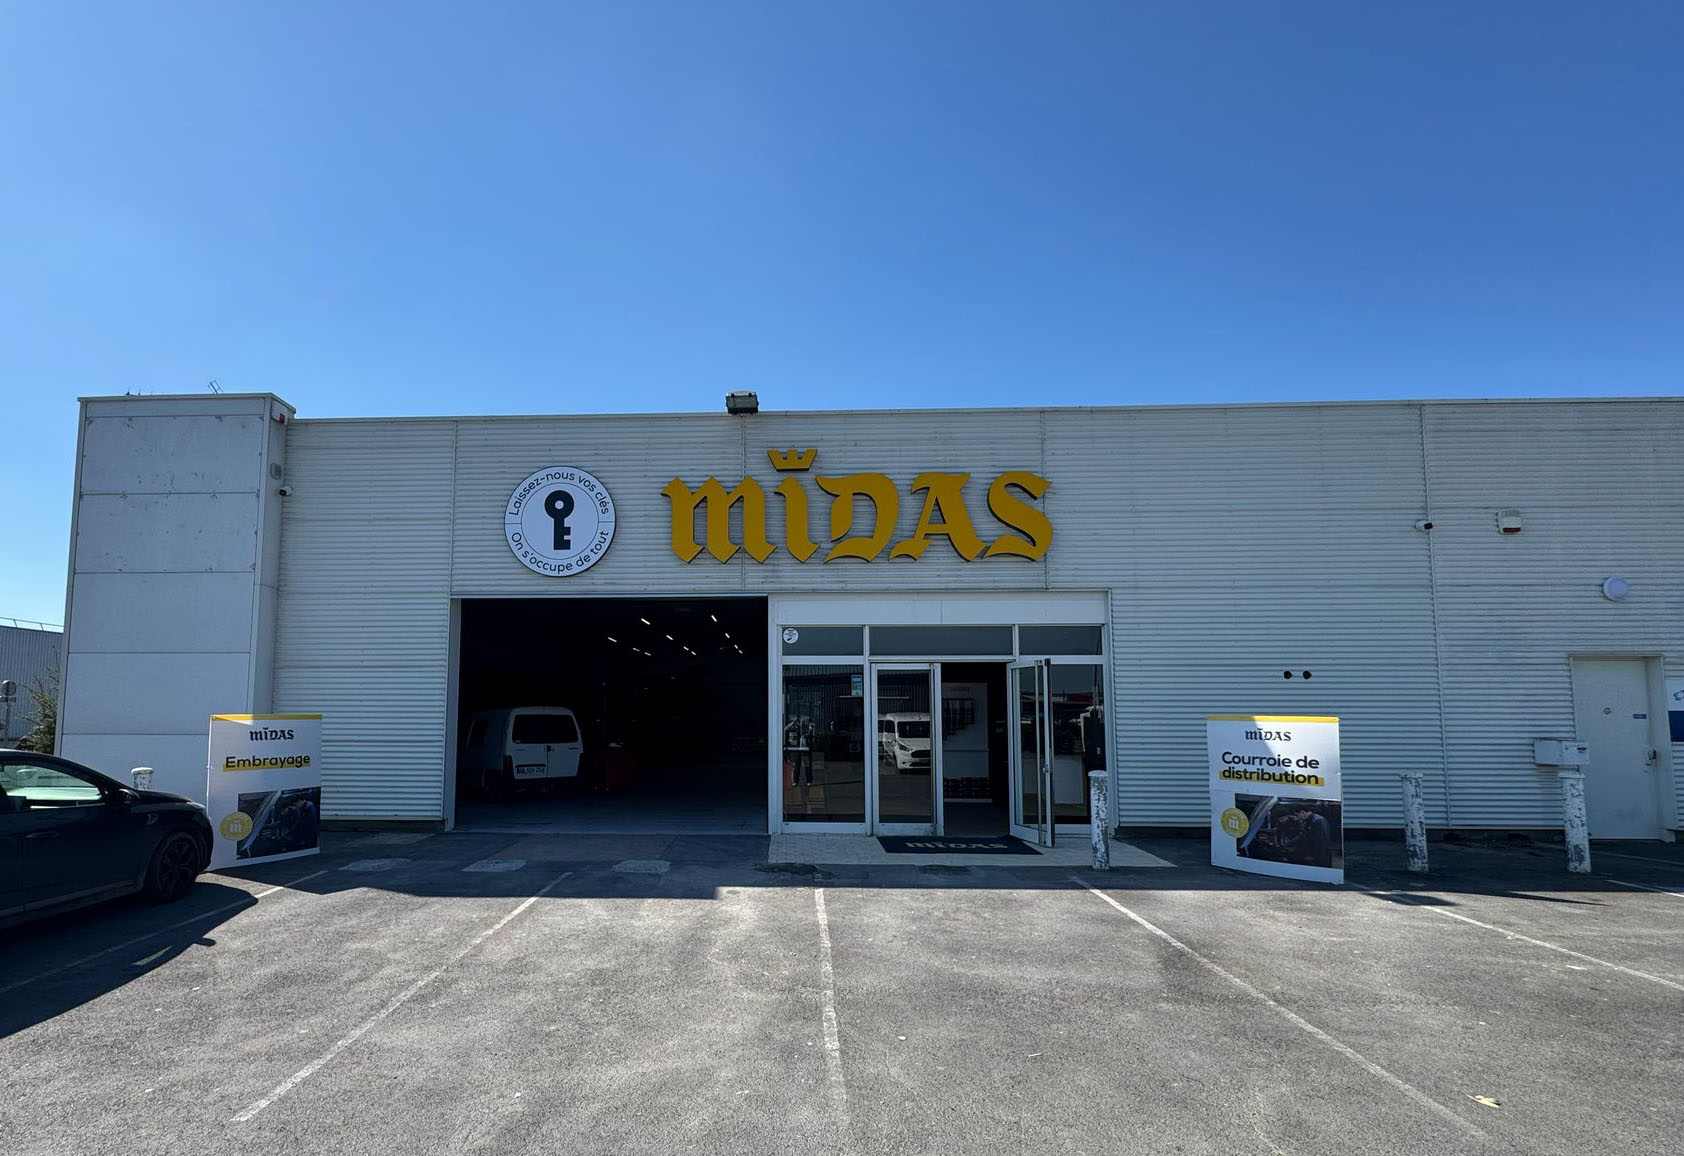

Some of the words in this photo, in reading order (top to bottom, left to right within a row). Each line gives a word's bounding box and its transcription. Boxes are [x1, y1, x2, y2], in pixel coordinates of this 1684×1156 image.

[509, 471, 575, 516] Laissez-nous
[578, 475, 597, 492] vos
[595, 491, 609, 514] clés
[511, 532, 524, 551] On
[521, 550, 573, 574] s'occupe
[575, 554, 591, 567] de
[590, 530, 609, 555] tout
[225, 754, 311, 769] Embrayage
[1221, 751, 1292, 768] Courroie
[1296, 755, 1320, 769] de
[1222, 766, 1319, 785] distribution
